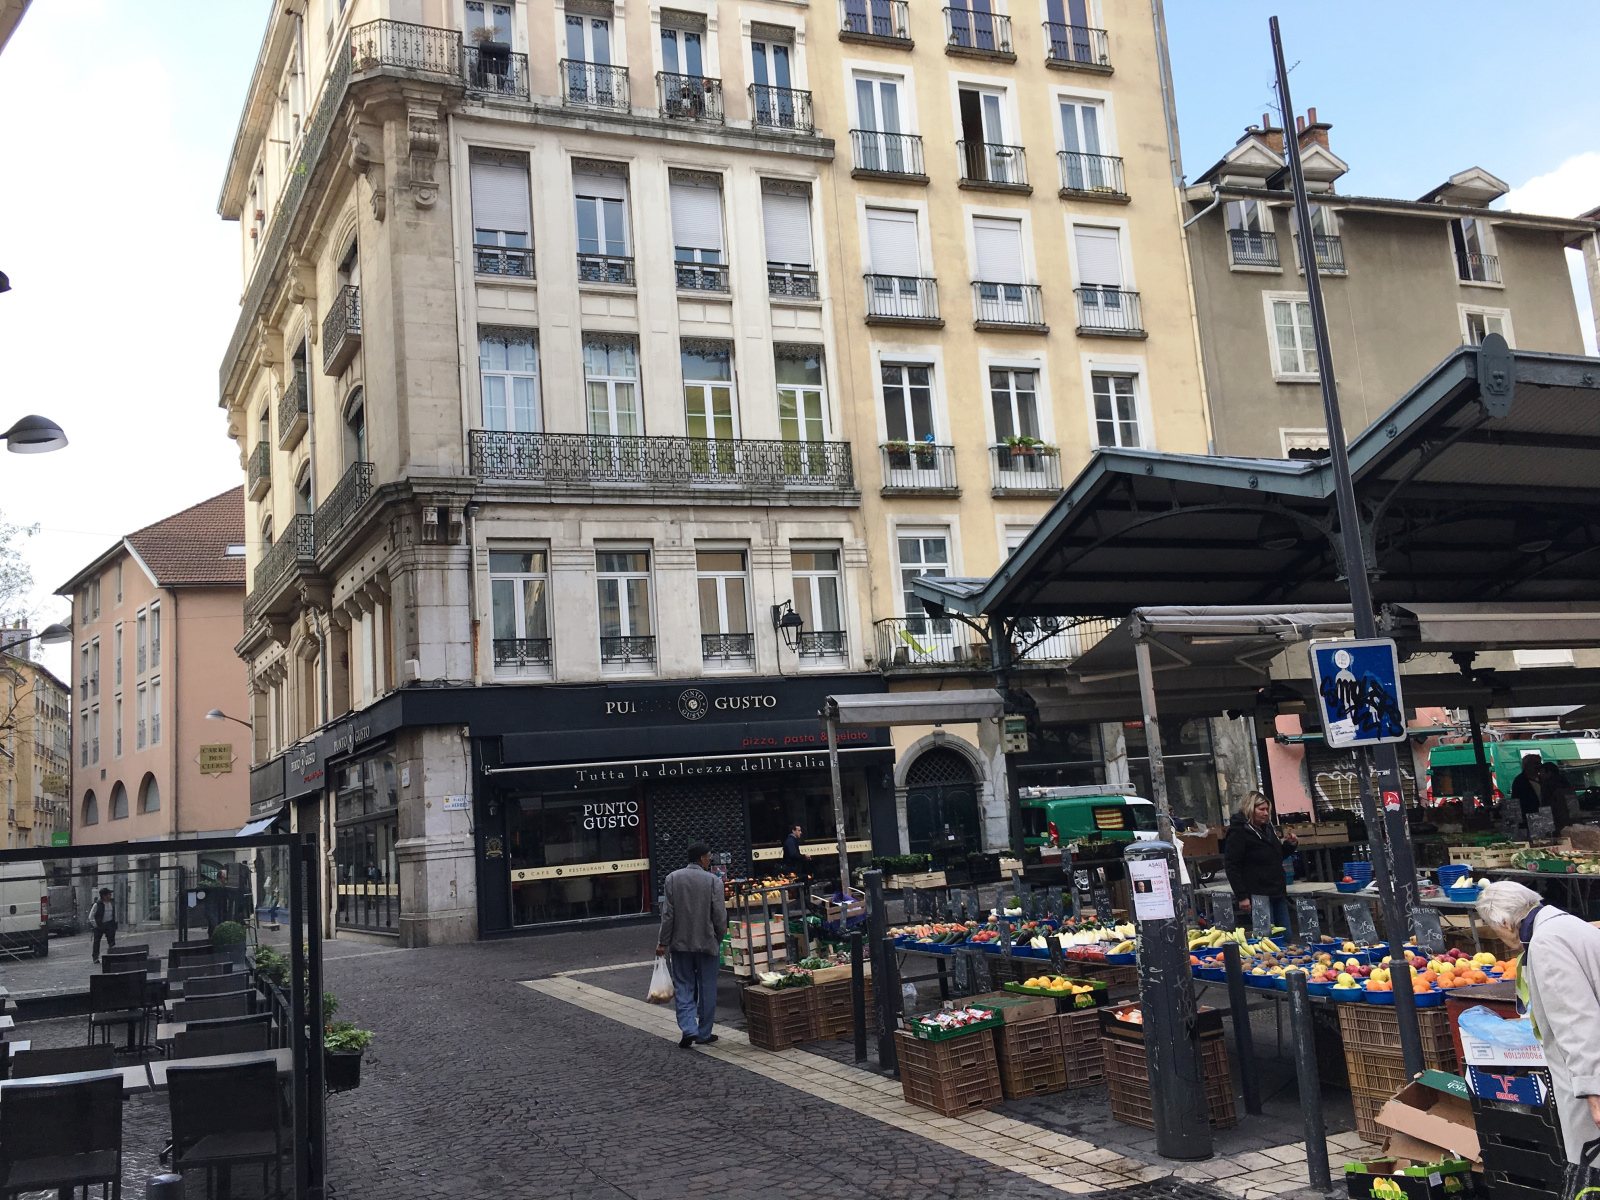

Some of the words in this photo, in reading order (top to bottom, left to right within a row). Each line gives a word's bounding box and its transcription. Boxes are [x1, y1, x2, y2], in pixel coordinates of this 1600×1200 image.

[682, 690, 703, 700] PUNTO
[714, 695, 777, 710] GUSTO
[681, 709, 705, 719] GUSTO
[354, 726, 370, 742] GUSTO
[742, 736, 778, 748] pizza,
[784, 734, 815, 745] pasta
[576, 770, 625, 782] Tutta
[634, 765, 649, 777] la
[658, 762, 732, 776] dolcezza
[741, 756, 825, 771] dell'Italia
[583, 801, 638, 816] PUNTO
[583, 814, 640, 830] GUSTO
[569, 865, 605, 873] RESTAURANT
[1503, 1052, 1543, 1060] PRODUCTION
[1369, 1188, 1409, 1200] TOMAS
